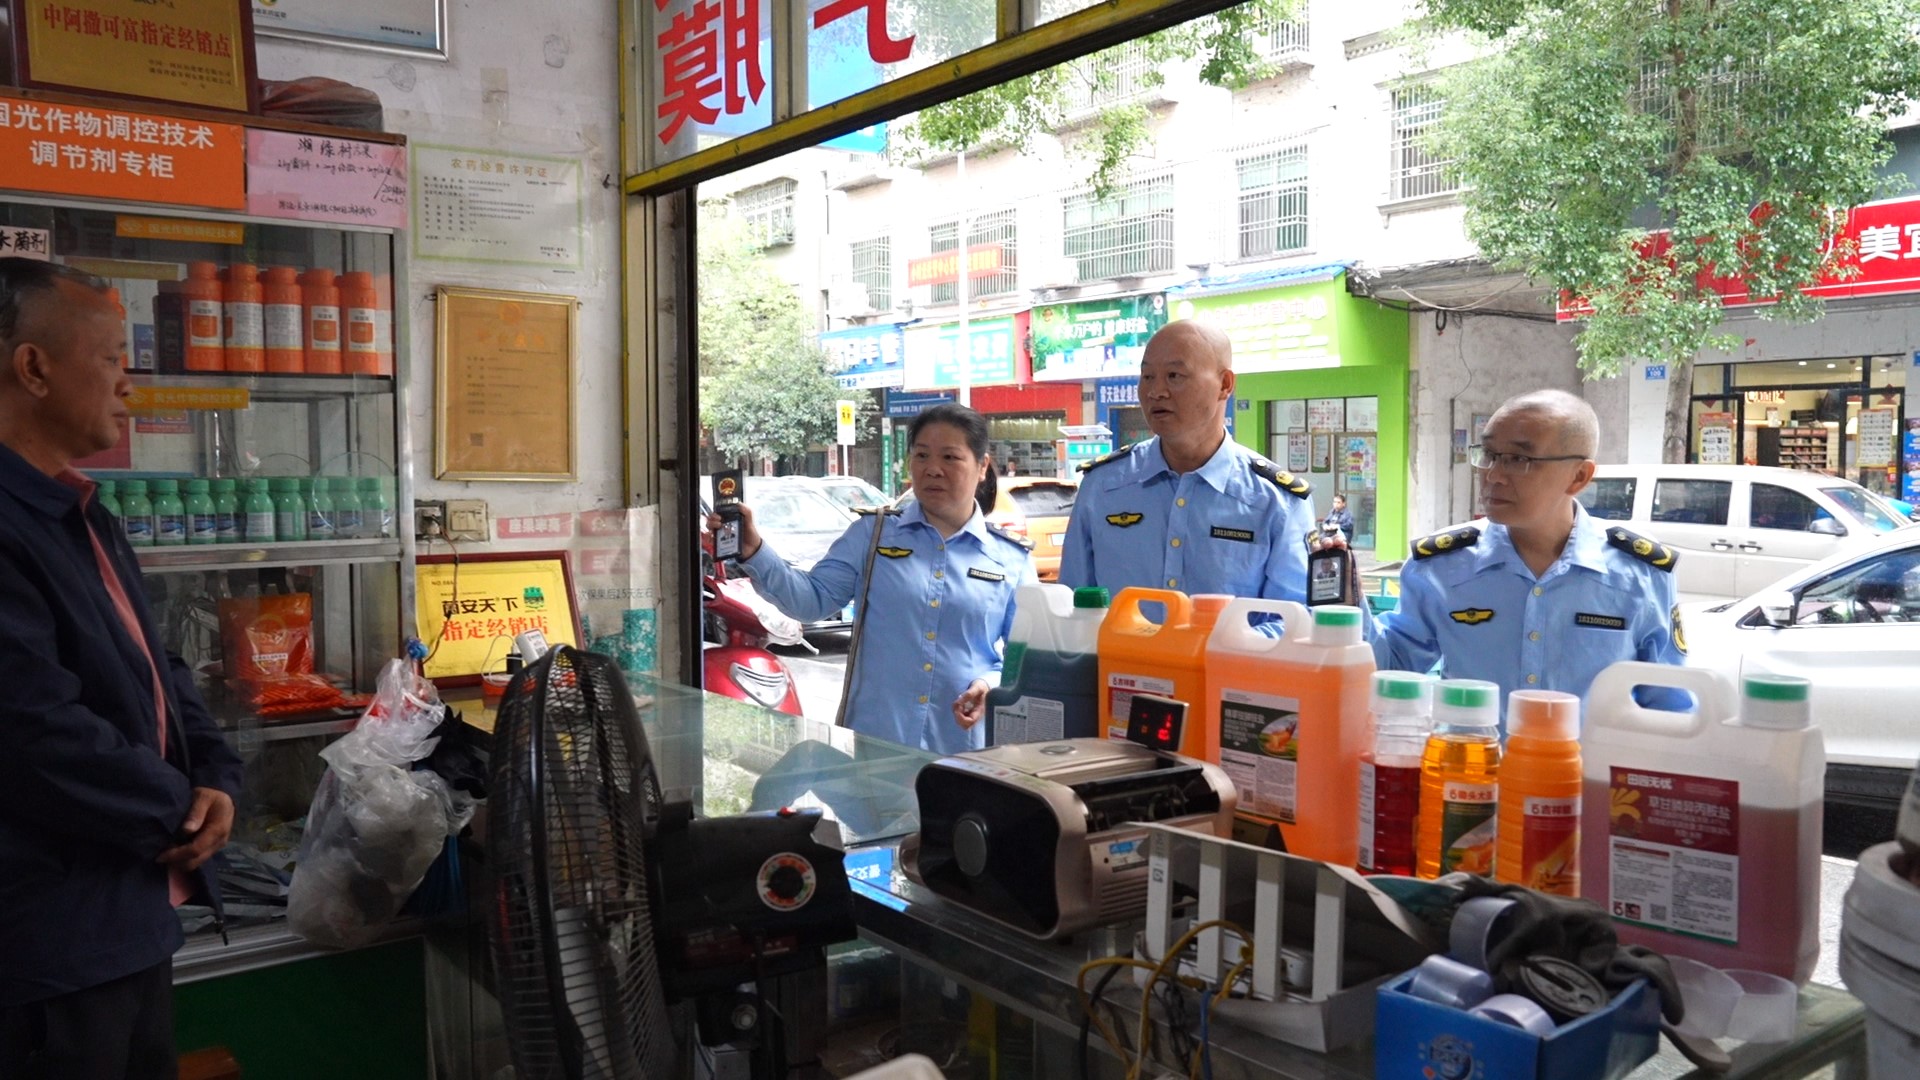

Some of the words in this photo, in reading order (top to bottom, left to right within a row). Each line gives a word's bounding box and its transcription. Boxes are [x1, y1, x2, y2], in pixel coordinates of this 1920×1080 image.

[30, 140, 174, 179] 调节剂专柜
[451, 158, 547, 178] 农药经营许可证
[148, 223, 238, 238] 国光作物调控技术
